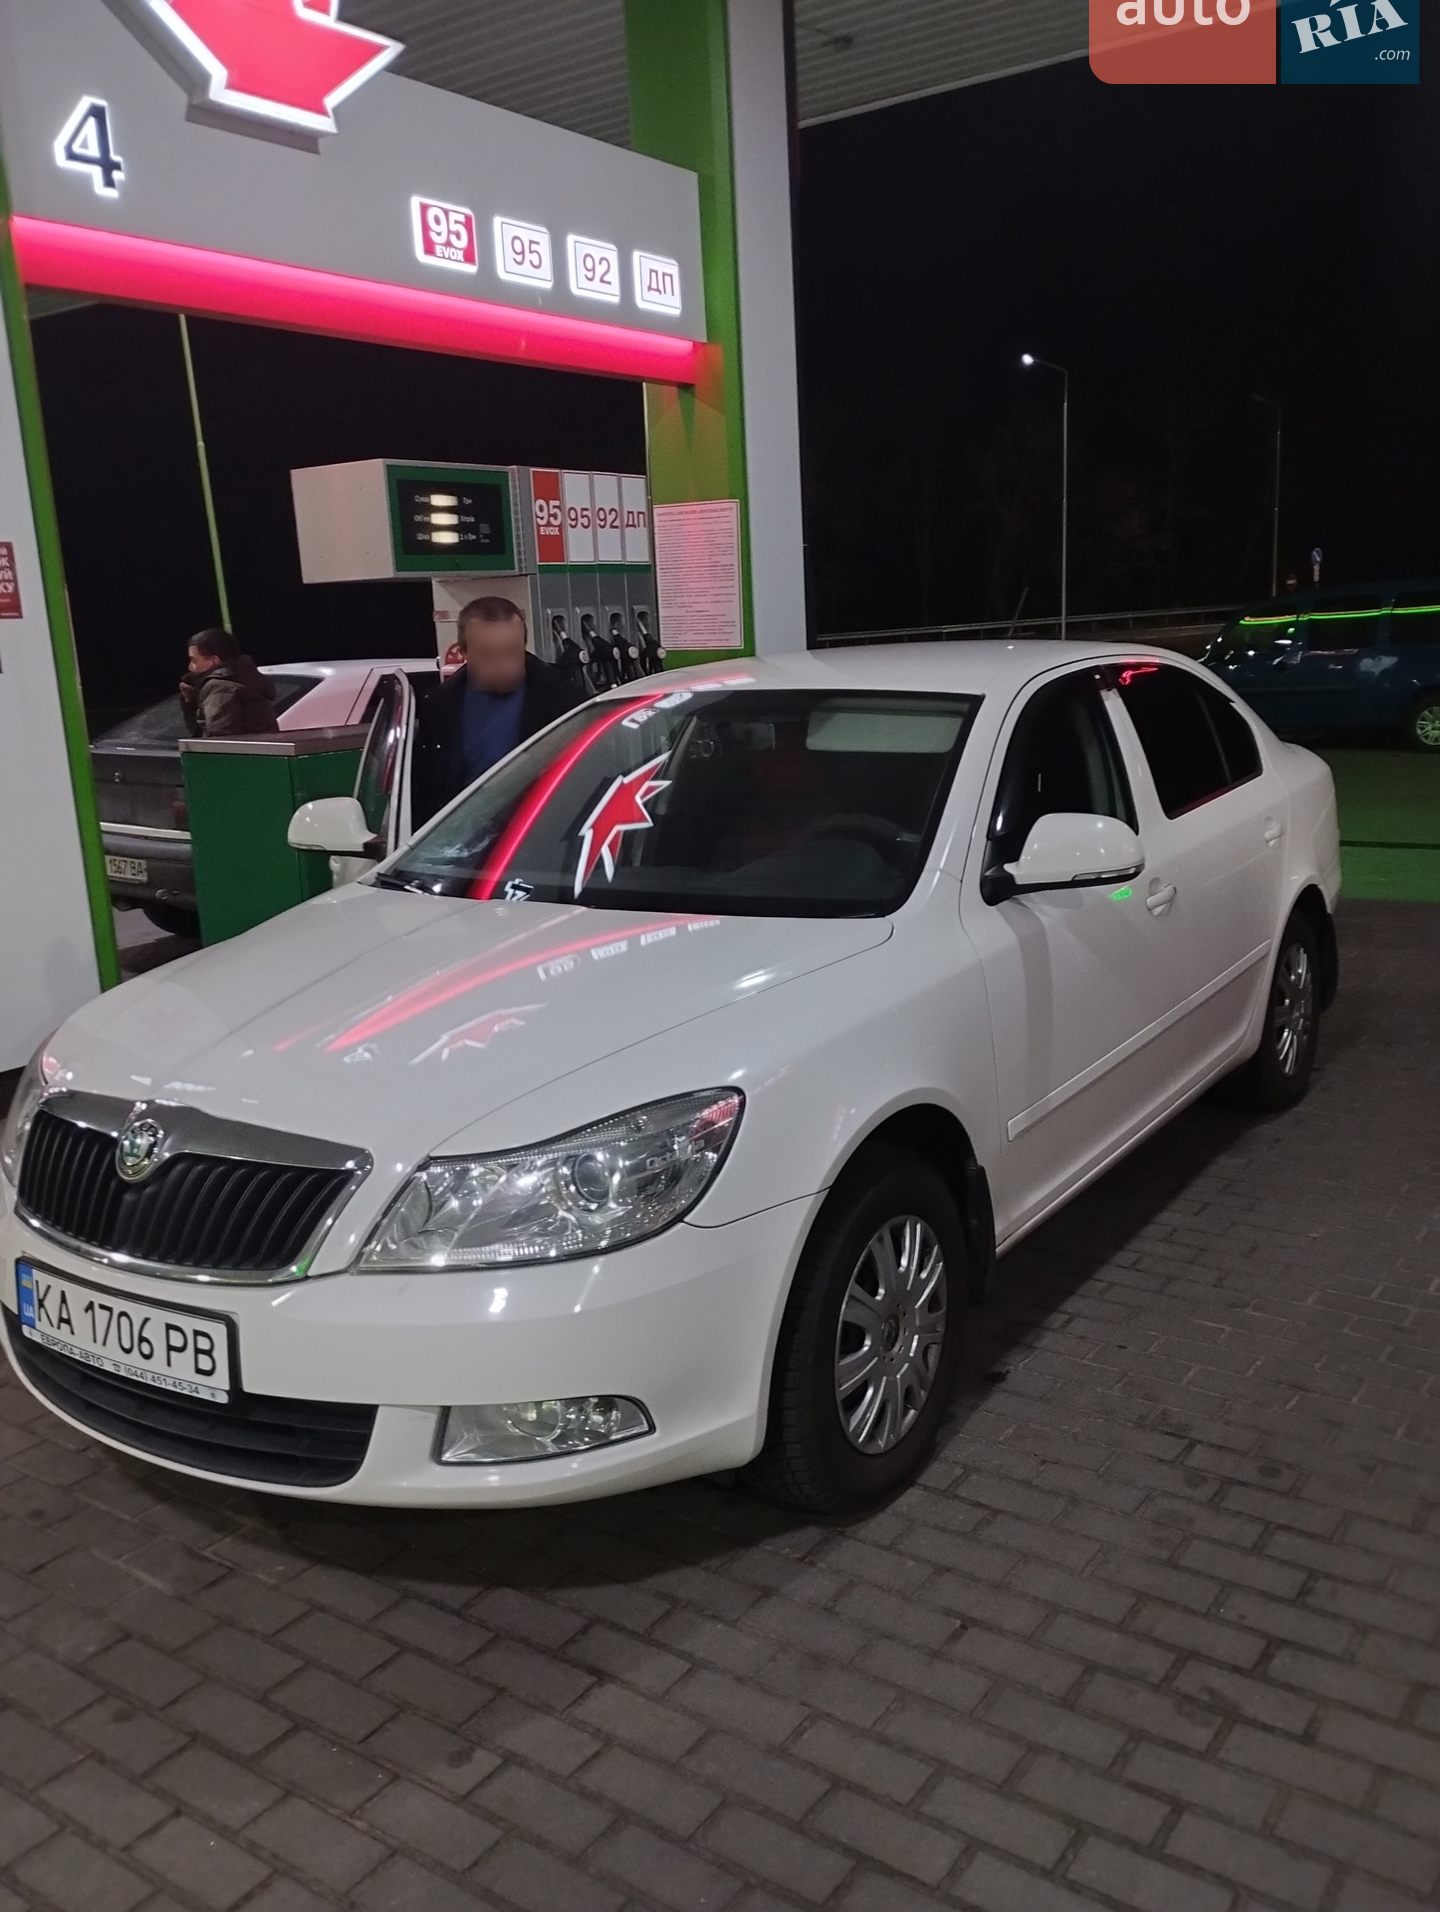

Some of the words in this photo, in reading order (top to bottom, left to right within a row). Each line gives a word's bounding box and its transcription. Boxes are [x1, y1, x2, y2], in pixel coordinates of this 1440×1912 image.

[56, 96, 123, 196] 4
[427, 206, 469, 250] 95
[435, 245, 465, 263] EVOX
[511, 235, 543, 270] 95
[582, 252, 613, 286] 92
[647, 268, 675, 297] ДП
[535, 499, 562, 526] 95
[568, 506, 591, 529] 95
[597, 507, 619, 529] 92
[625, 510, 647, 529] ДП
[540, 526, 560, 536] EVOX
[23, 1304, 35, 1319] UA
[35, 1279, 75, 1336] KA
[84, 1301, 155, 1360] 1706
[165, 1322, 216, 1377] PB
[40, 1334, 105, 1367] ЕВРОПА-АВТО
[124, 1366, 148, 1382] (044)
[151, 1376, 200, 1395] 451-45-34
